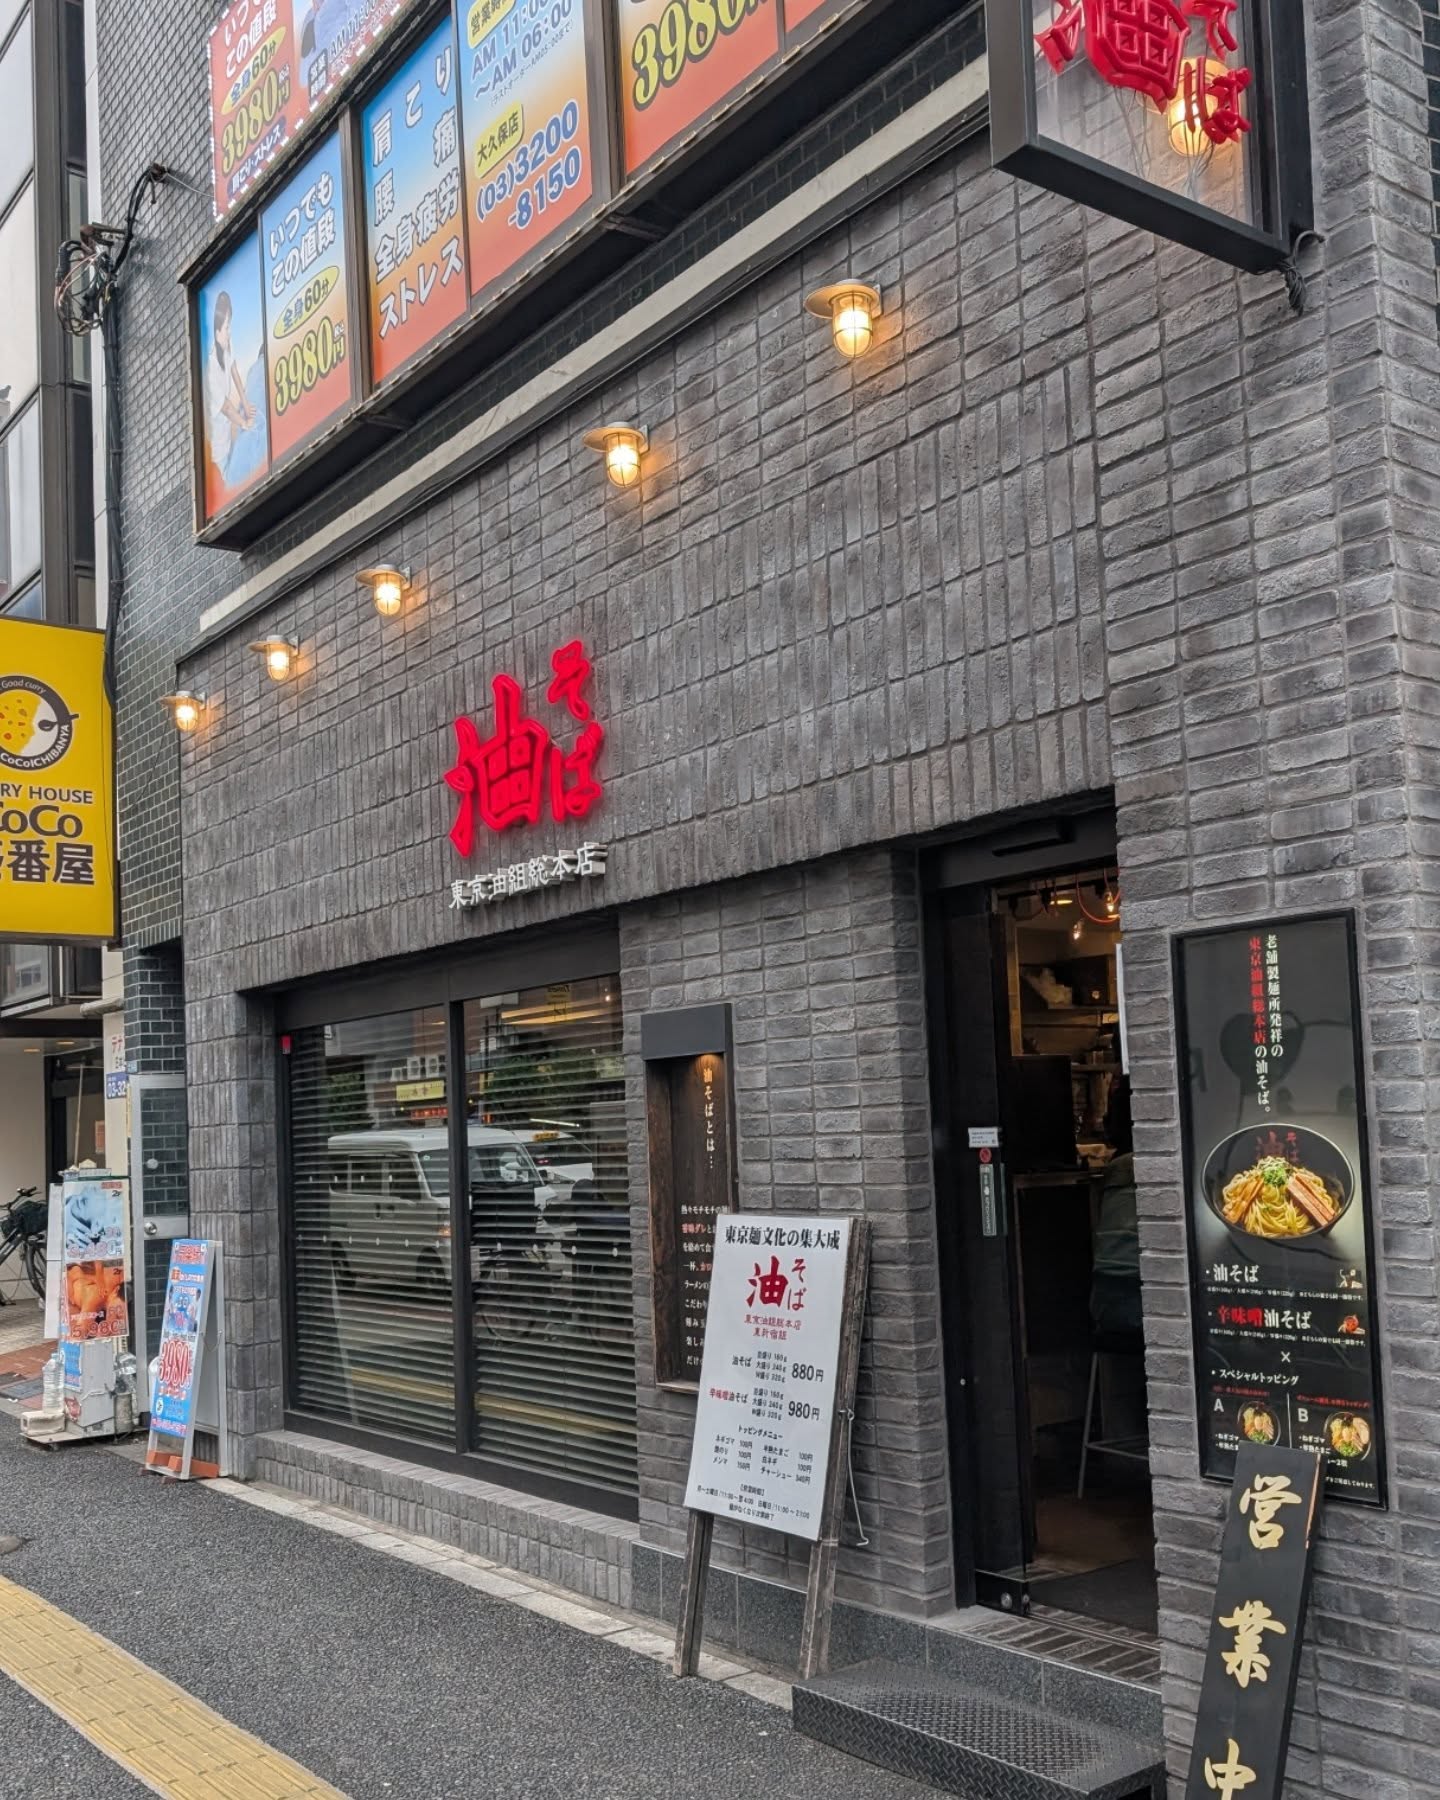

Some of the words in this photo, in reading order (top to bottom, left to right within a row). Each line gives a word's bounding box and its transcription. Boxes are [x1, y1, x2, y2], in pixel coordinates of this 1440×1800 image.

[472, 36, 497, 81] AM
[477, 110, 519, 169] 大久保店
[268, 171, 333, 261] いつでも
[373, 167, 459, 285] 全身疲労
[270, 207, 336, 298] この値段
[379, 236, 464, 339] ストレス
[443, 639, 604, 859] 油そば
[29, 785, 94, 804] HOUSE
[0, 839, 95, 886] 番屋
[449, 841, 609, 911] 東京油組総本店
[1265, 933, 1284, 1058] 老舗製麺所発祥の
[724, 1224, 841, 1251] 東京麺文化の集大成
[745, 1254, 807, 1312] 油そば
[1212, 1263, 1260, 1283] 油そば
[731, 1354, 753, 1368] 油そば
[791, 1362, 825, 1383] 880円
[1219, 1368, 1299, 1387] スペシャルトッピング
[787, 1400, 821, 1421] 980円
[1213, 1397, 1225, 1413] A
[1297, 1407, 1309, 1422] B
[1203, 1473, 1303, 1800] 営業中
